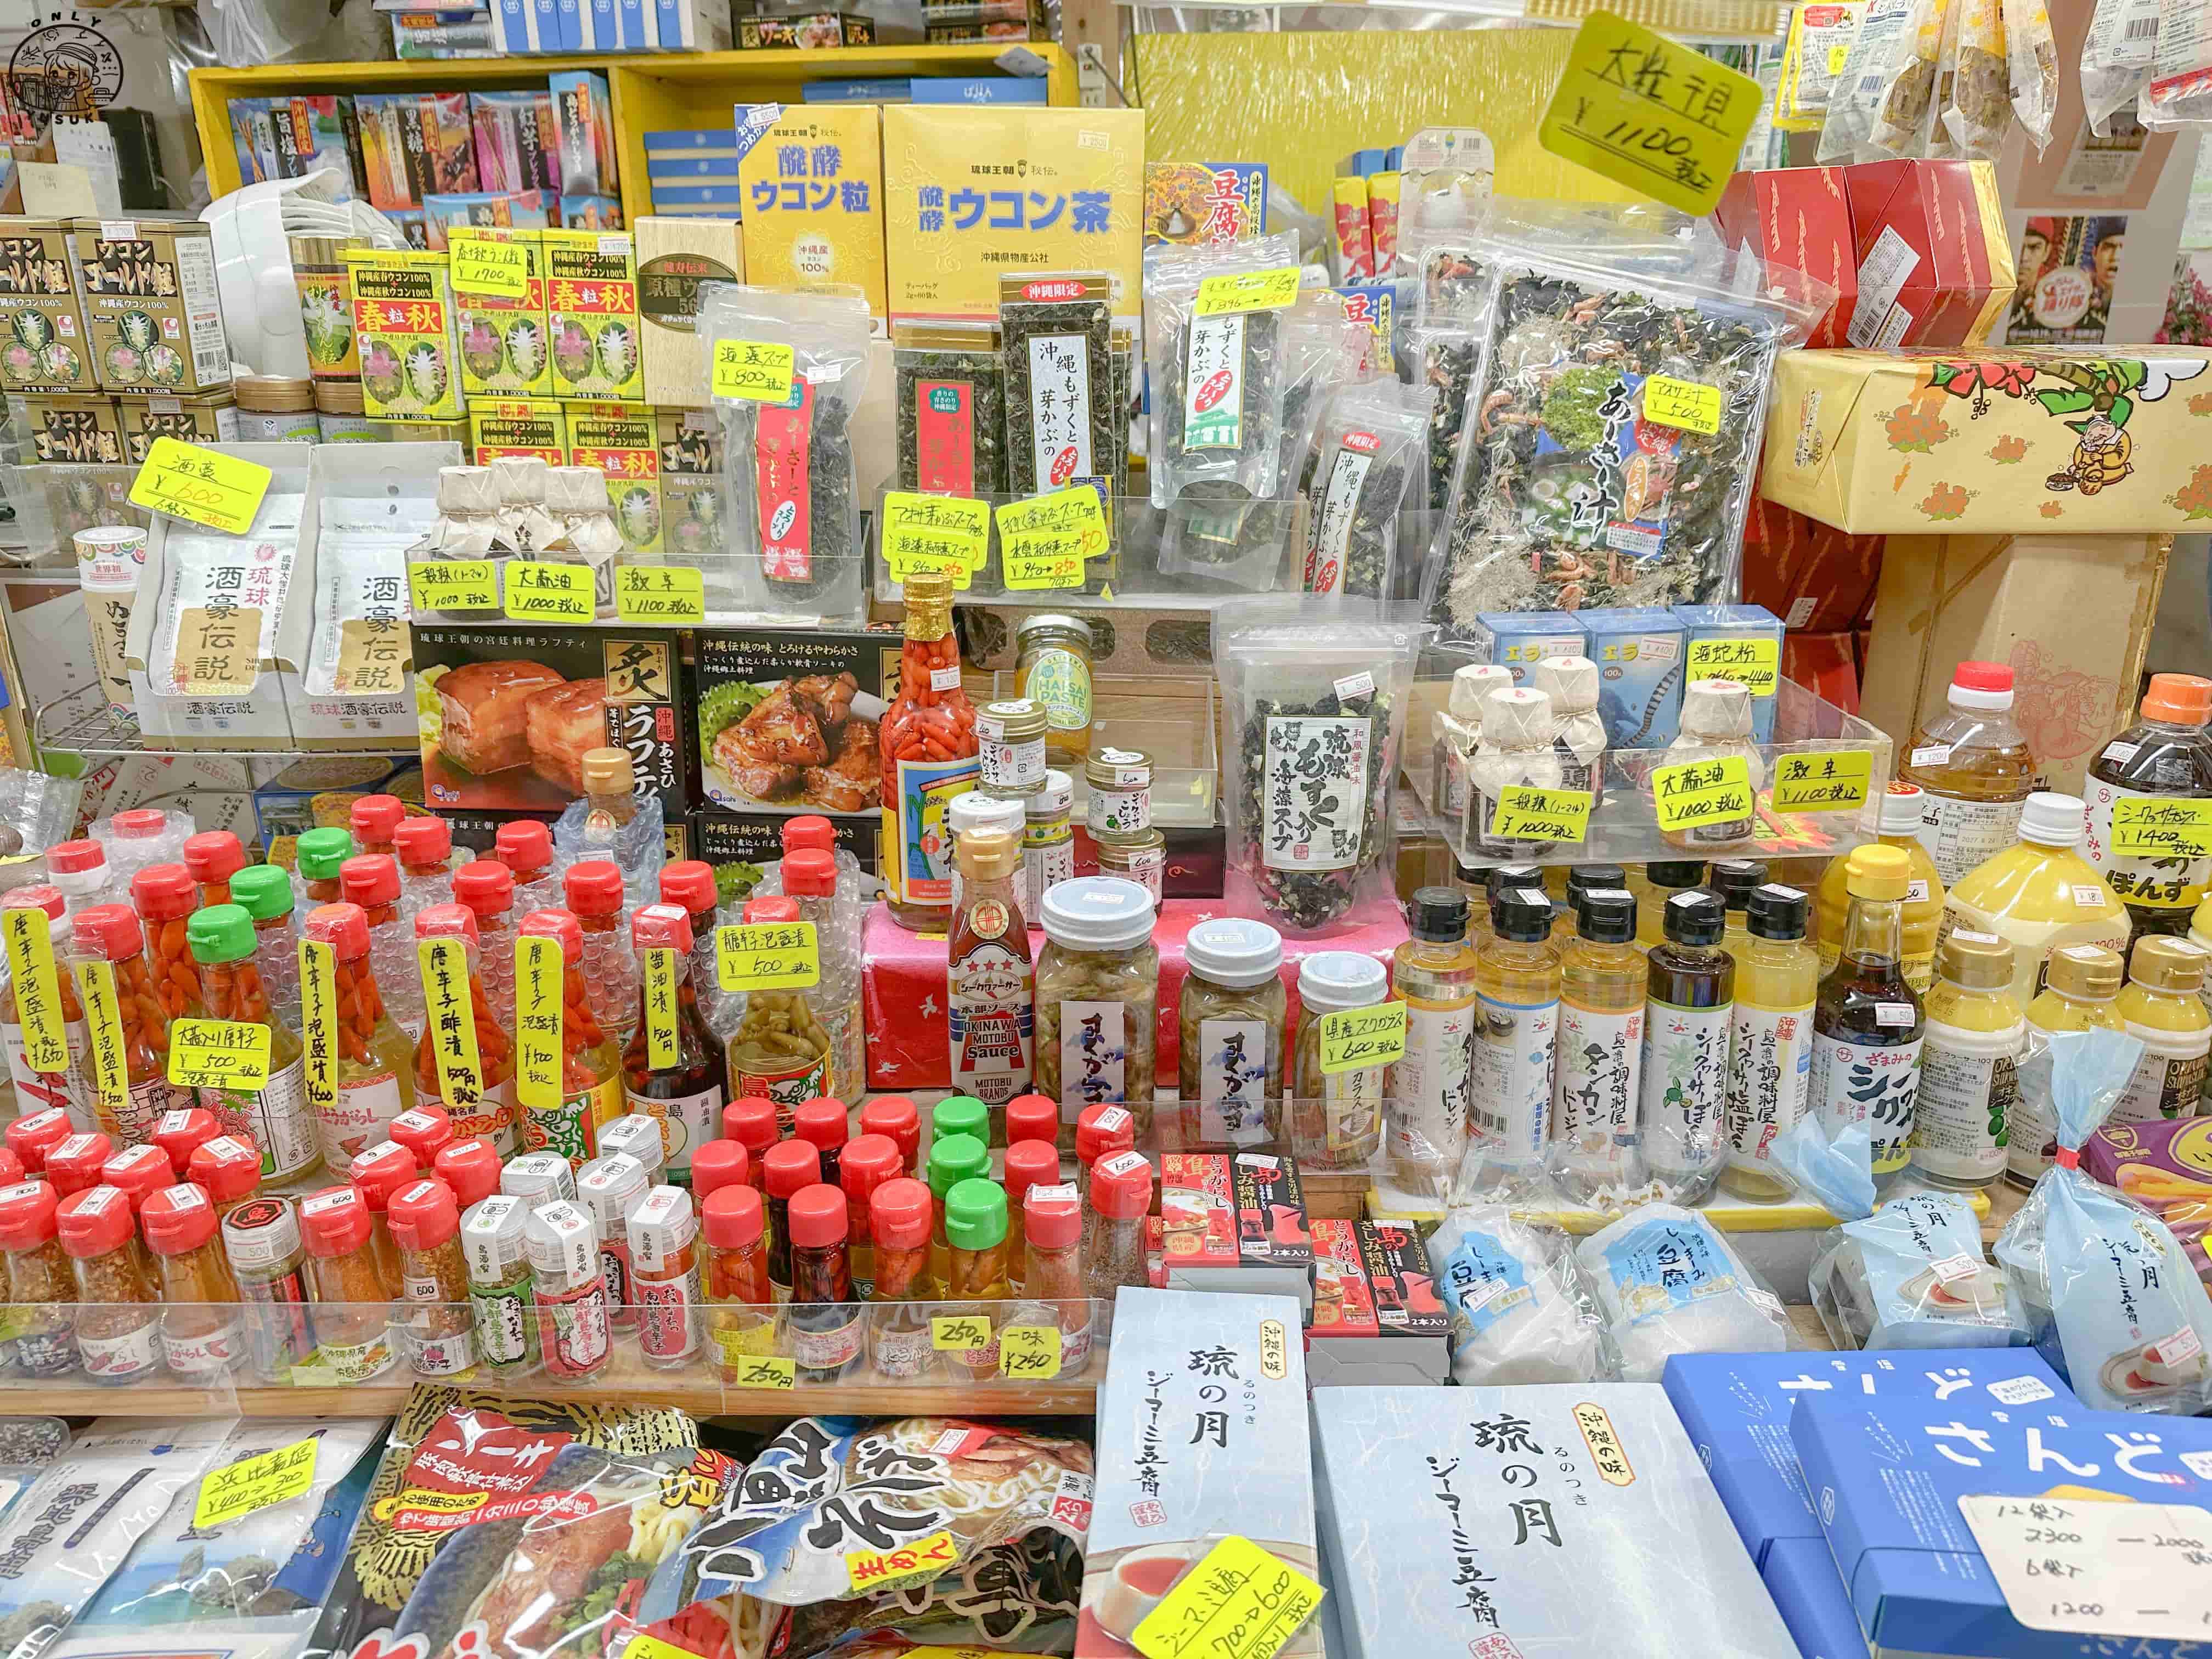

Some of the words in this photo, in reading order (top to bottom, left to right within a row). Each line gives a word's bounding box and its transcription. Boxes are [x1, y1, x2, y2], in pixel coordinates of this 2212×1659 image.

[752, 180, 870, 212] ウコン粒
[950, 188, 1111, 234] ウコン茶
[552, 251, 626, 264] 沖縄産春ウコン100%
[980, 252, 1049, 264] 沖縄県物産公社
[553, 266, 626, 278] 沖縄産秋ウコン100%
[800, 263, 829, 273] 100%
[357, 271, 430, 284] 沖縄産春ウコン100%
[359, 285, 432, 298] 沖縄産秋ウコン100%
[98, 297, 169, 310] 沖縄産ウコン100%
[1192, 330, 1210, 383] 芽かぶの
[481, 421, 554, 433] 沖縄産春ウコン100%
[578, 422, 648, 434] 沖縄産春ウコン100%
[1040, 390, 1058, 456] 芽かぶの
[483, 435, 555, 446] 沖縄産秋ウコン100%
[578, 435, 649, 447] 沖縄産秋ウコン100%
[246, 566, 273, 606] 琉球
[194, 566, 246, 682] 酒豪伝説
[353, 576, 400, 690] 酒豪伝説
[420, 633, 589, 648] 琉球王朝の宮廷料理ラフティ
[703, 640, 773, 654] 沖縄伝統の味
[778, 643, 859, 656] とろけるやわらかさ
[1042, 692, 1086, 709] PASTE
[310, 702, 407, 716] 琉球酒豪伝説
[657, 742, 676, 789] あさひ
[705, 823, 772, 836] 沖縄伝統の味
[2106, 872, 2190, 902] ぽんず
[960, 1003, 1022, 1015] 本部ソース
[964, 1018, 1022, 1032] OKINAWA
[972, 1031, 1014, 1044] MOTOBU
[967, 1045, 1019, 1060] Sauce
[1865, 1052, 1912, 1066] ざまみの
[974, 1077, 1012, 1089] MOTOBU
[1272, 1248, 1310, 1258] 2本入り
[1656, 1243, 1689, 1289] 豆腐
[416, 1285, 435, 1295] 600
[1410, 1317, 1448, 1327] 2本入り
[1187, 1345, 1239, 1448] 琉の月
[1243, 1378, 1256, 1425] るのつき
[1131, 1369, 1174, 1497] ジーマーミ豆腐
[1578, 1412, 1627, 1477] 沖縄の味
[1925, 1420, 2168, 1485] さんど
[1470, 1413, 1565, 1548] 琉の月
[1554, 1446, 1588, 1506] るのつき
[1426, 1456, 1500, 1629] ジーマーミ豆腐
[2024, 1527, 2081, 1544] 2300
[2051, 1602, 2104, 1617] 1200
